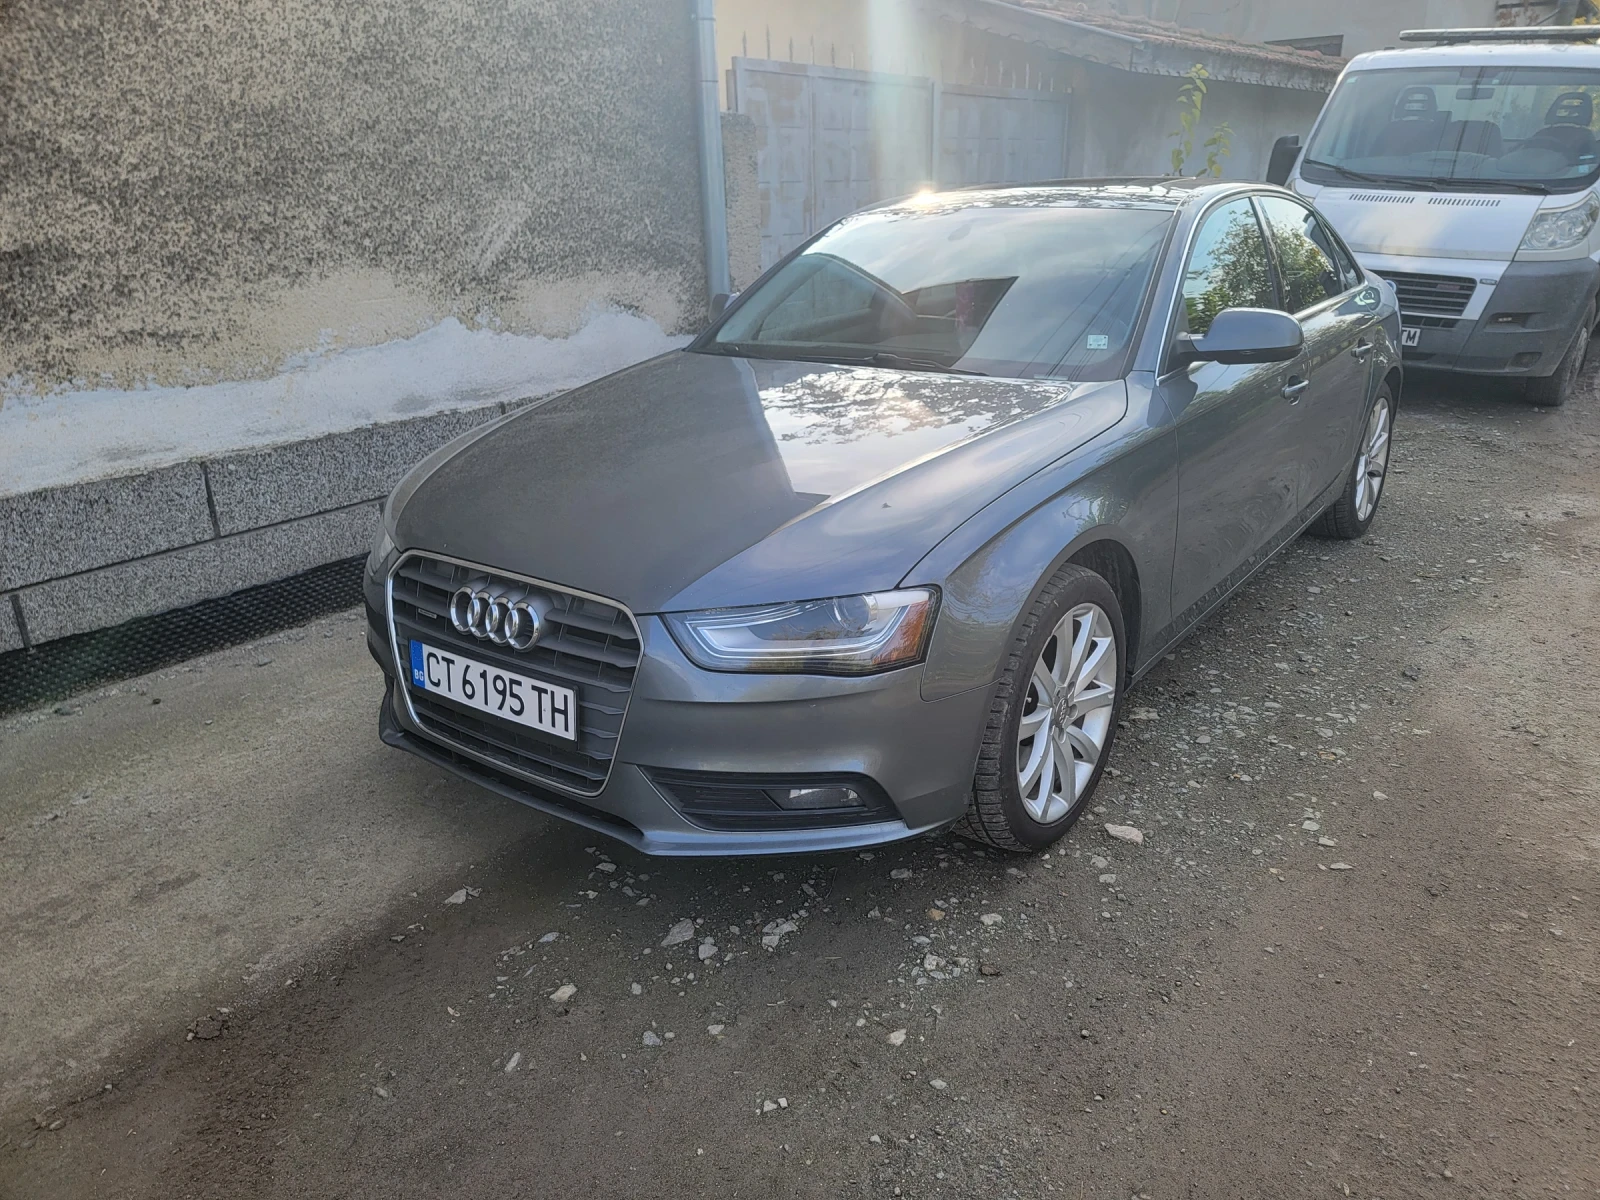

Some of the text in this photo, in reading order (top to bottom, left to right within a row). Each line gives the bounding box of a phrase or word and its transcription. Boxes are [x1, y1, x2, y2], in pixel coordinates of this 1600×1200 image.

[414, 669, 425, 682] BG
[426, 652, 569, 732] CT 6195 TH
